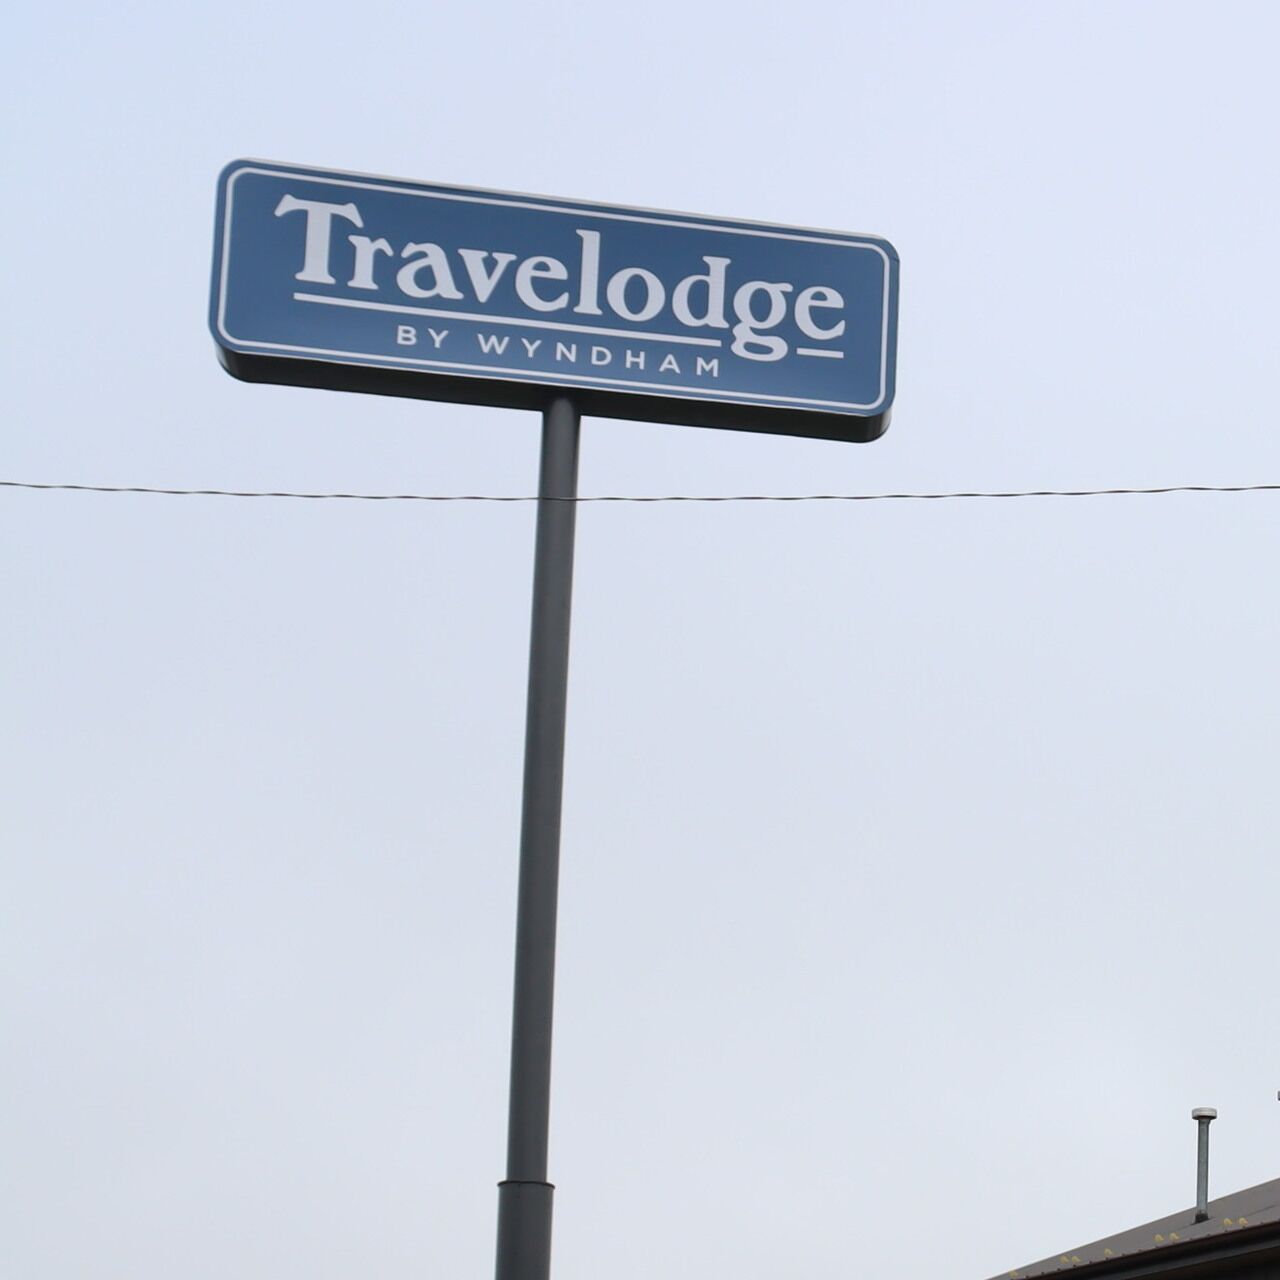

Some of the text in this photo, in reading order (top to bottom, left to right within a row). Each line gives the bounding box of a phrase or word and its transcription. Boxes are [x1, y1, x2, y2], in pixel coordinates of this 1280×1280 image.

[275, 194, 846, 362] Travelodge
[396, 324, 719, 377] BY WYNDHAM
